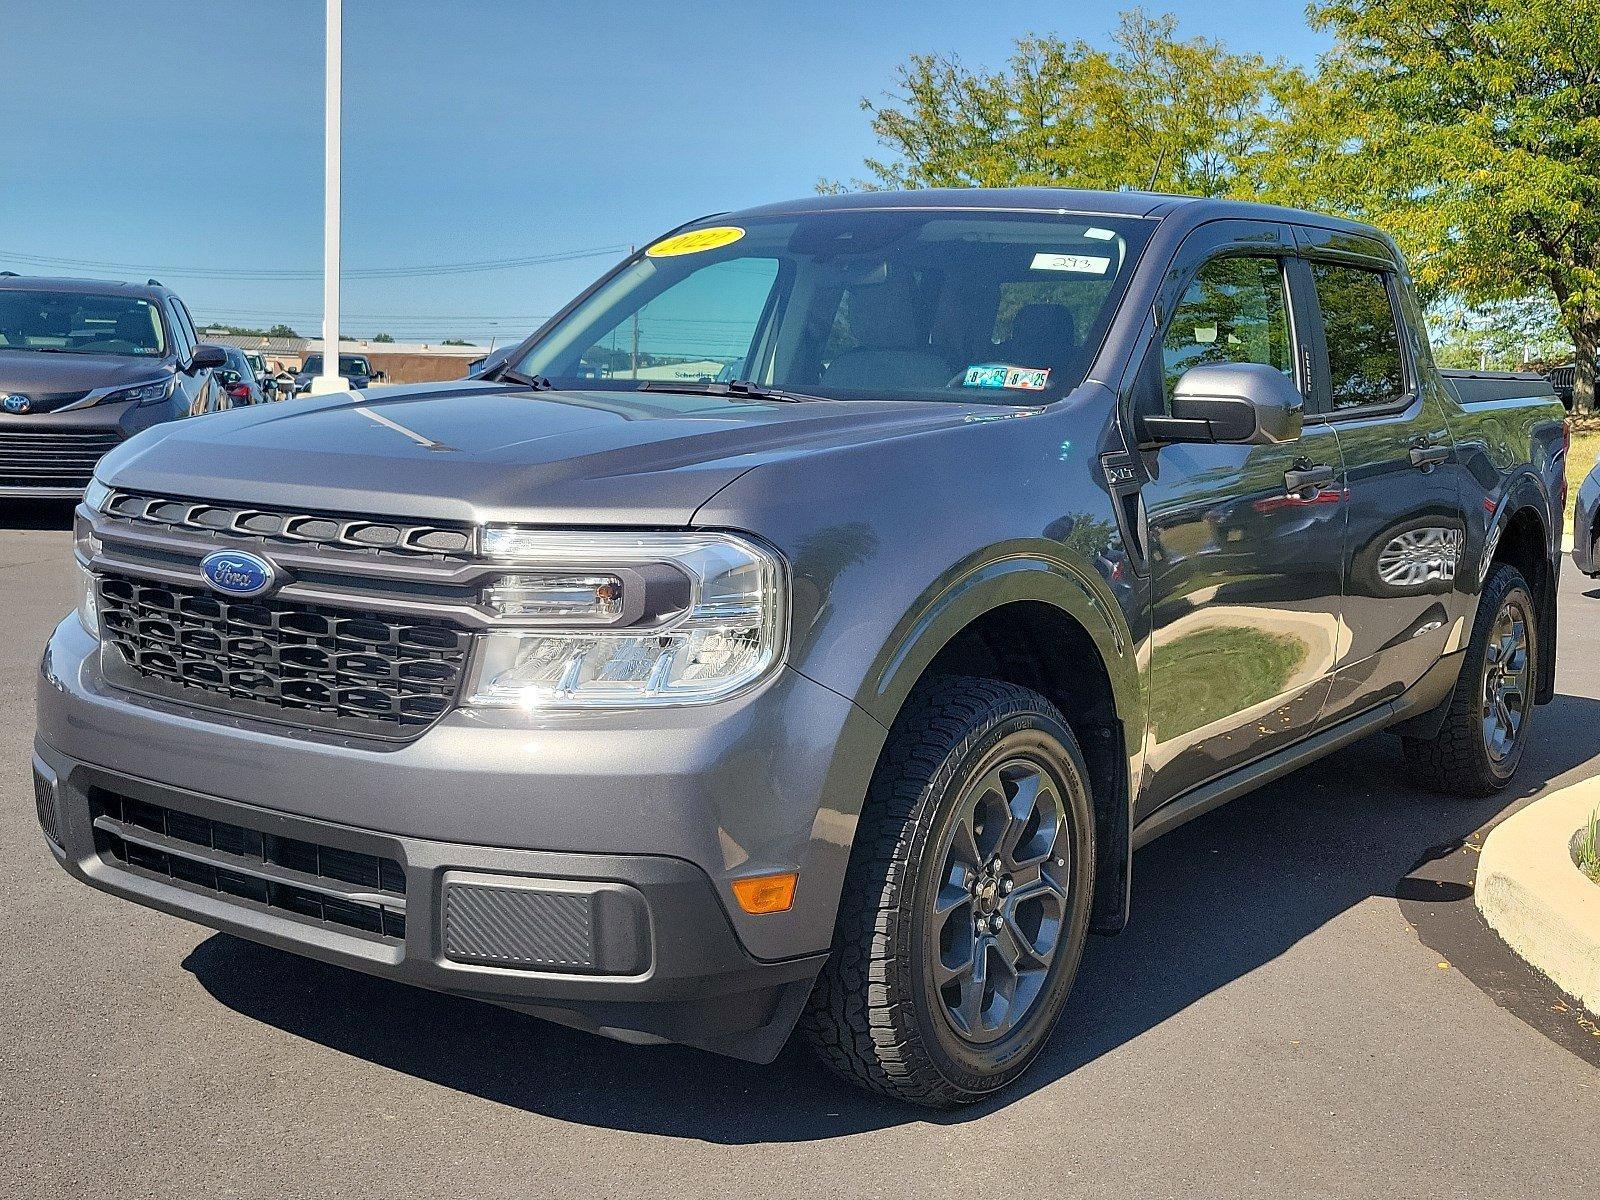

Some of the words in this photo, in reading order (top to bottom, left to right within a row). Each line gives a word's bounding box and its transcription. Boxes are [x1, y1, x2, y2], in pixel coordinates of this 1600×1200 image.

[970, 371, 979, 383] 8
[1011, 373, 1020, 386] 8
[1032, 373, 1047, 387] 25
[214, 560, 253, 587] Ford
